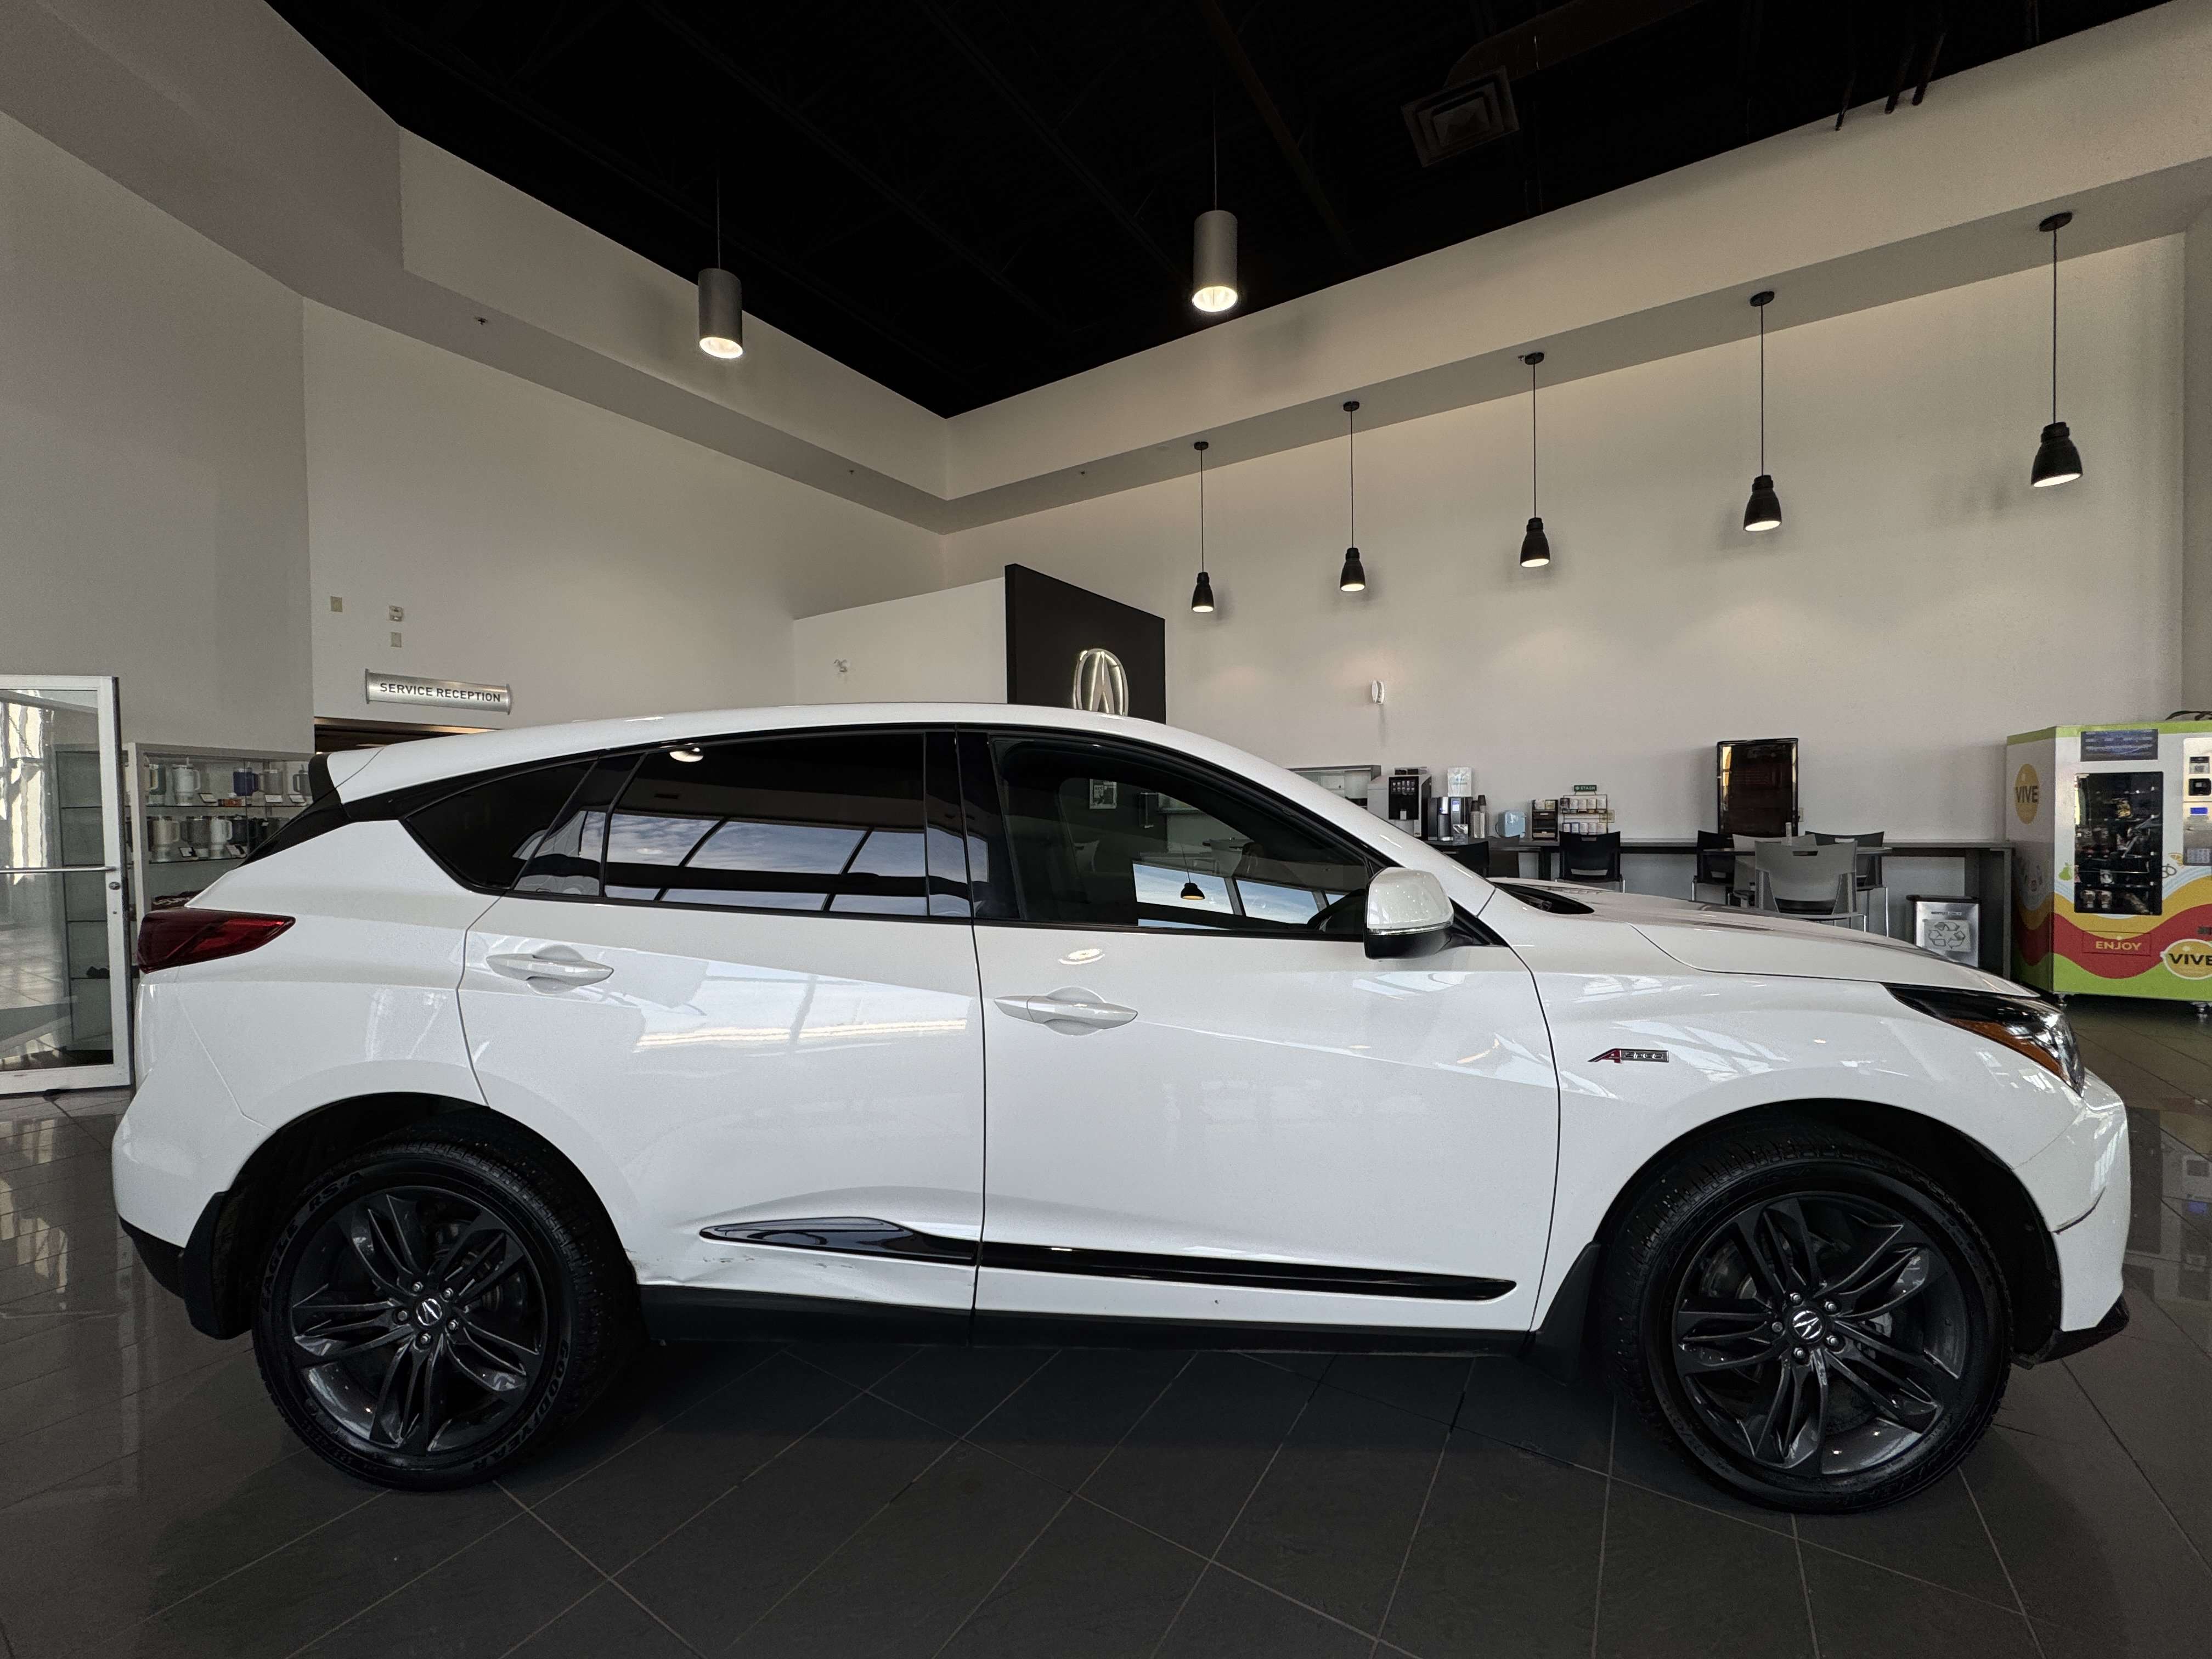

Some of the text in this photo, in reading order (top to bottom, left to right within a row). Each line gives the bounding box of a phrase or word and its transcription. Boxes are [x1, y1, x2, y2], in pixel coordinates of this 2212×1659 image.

[380, 683, 500, 702] SERVICE RECEPTION
[2016, 786, 2038, 803] VIVE
[2096, 941, 2142, 951] ENJOY
[2169, 953, 2212, 966] VIVE
[473, 1339, 570, 1466] GOODYEAR
